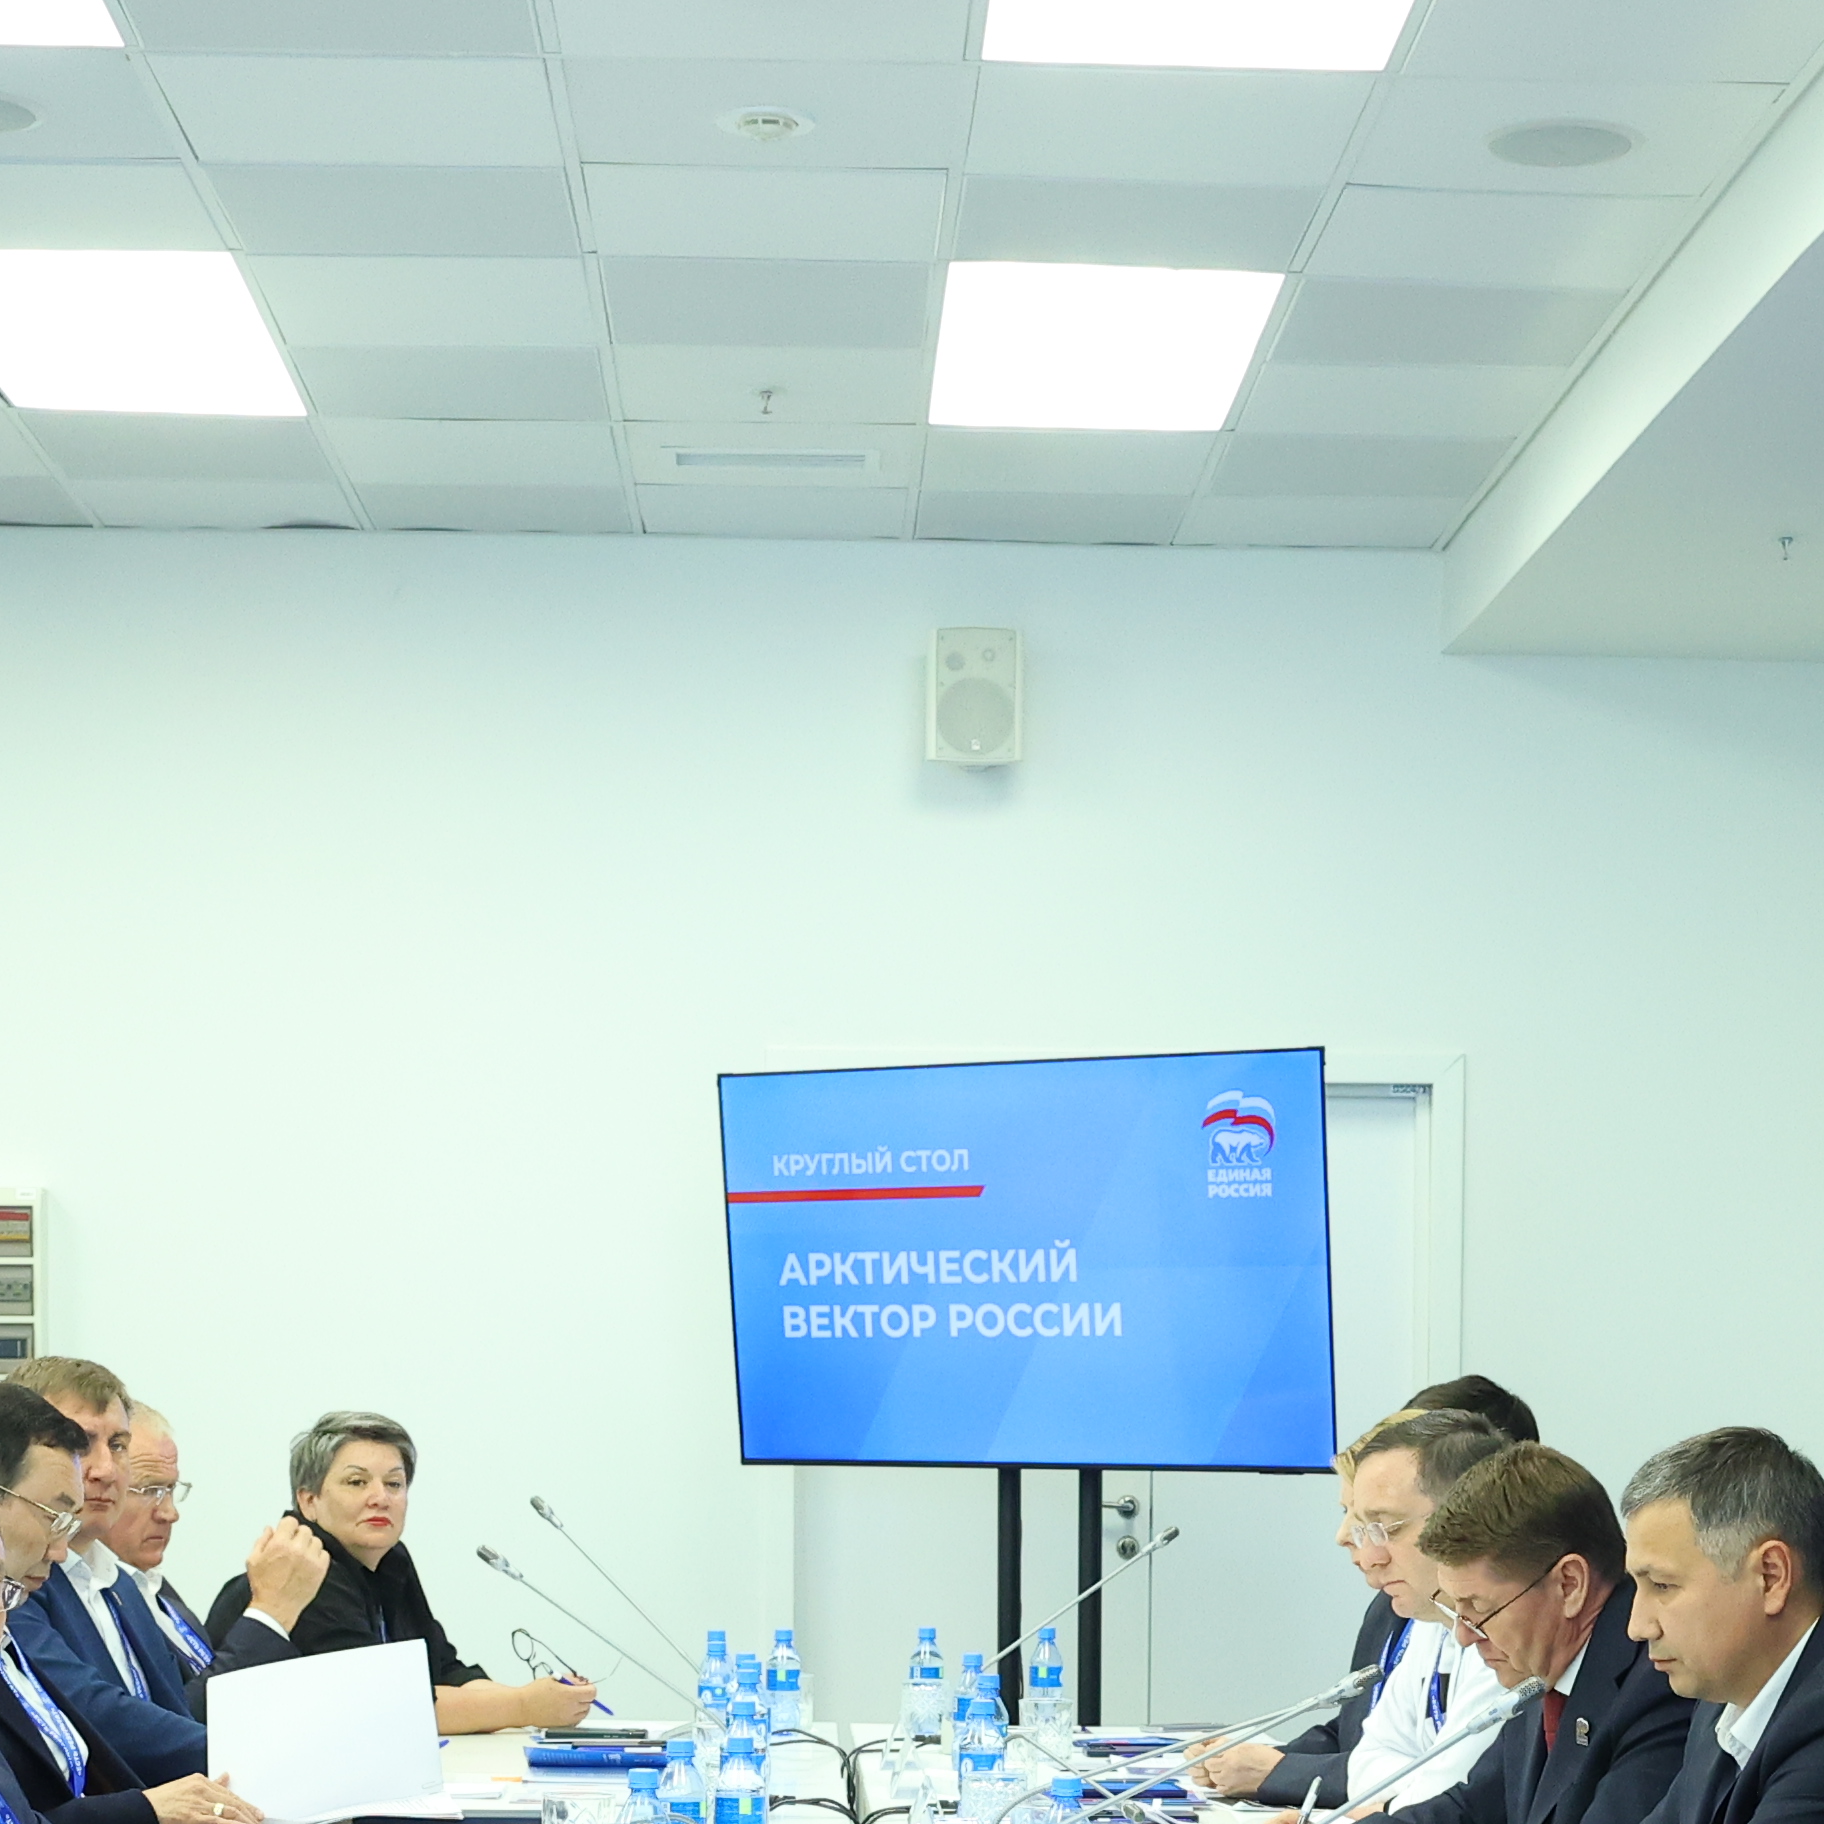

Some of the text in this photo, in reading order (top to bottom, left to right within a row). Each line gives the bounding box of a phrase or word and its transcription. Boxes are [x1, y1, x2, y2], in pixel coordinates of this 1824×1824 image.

[773, 1145, 969, 1177] КРУГЛЫЙ СТОЛ
[1207, 1168, 1272, 1183] ЕДИНАЯ
[1207, 1182, 1272, 1198] РОССИЯ
[779, 1240, 1078, 1287] АРКТИЧЕСКИЙ
[783, 1302, 1123, 1338] ВЕКТОР РОССИИ
